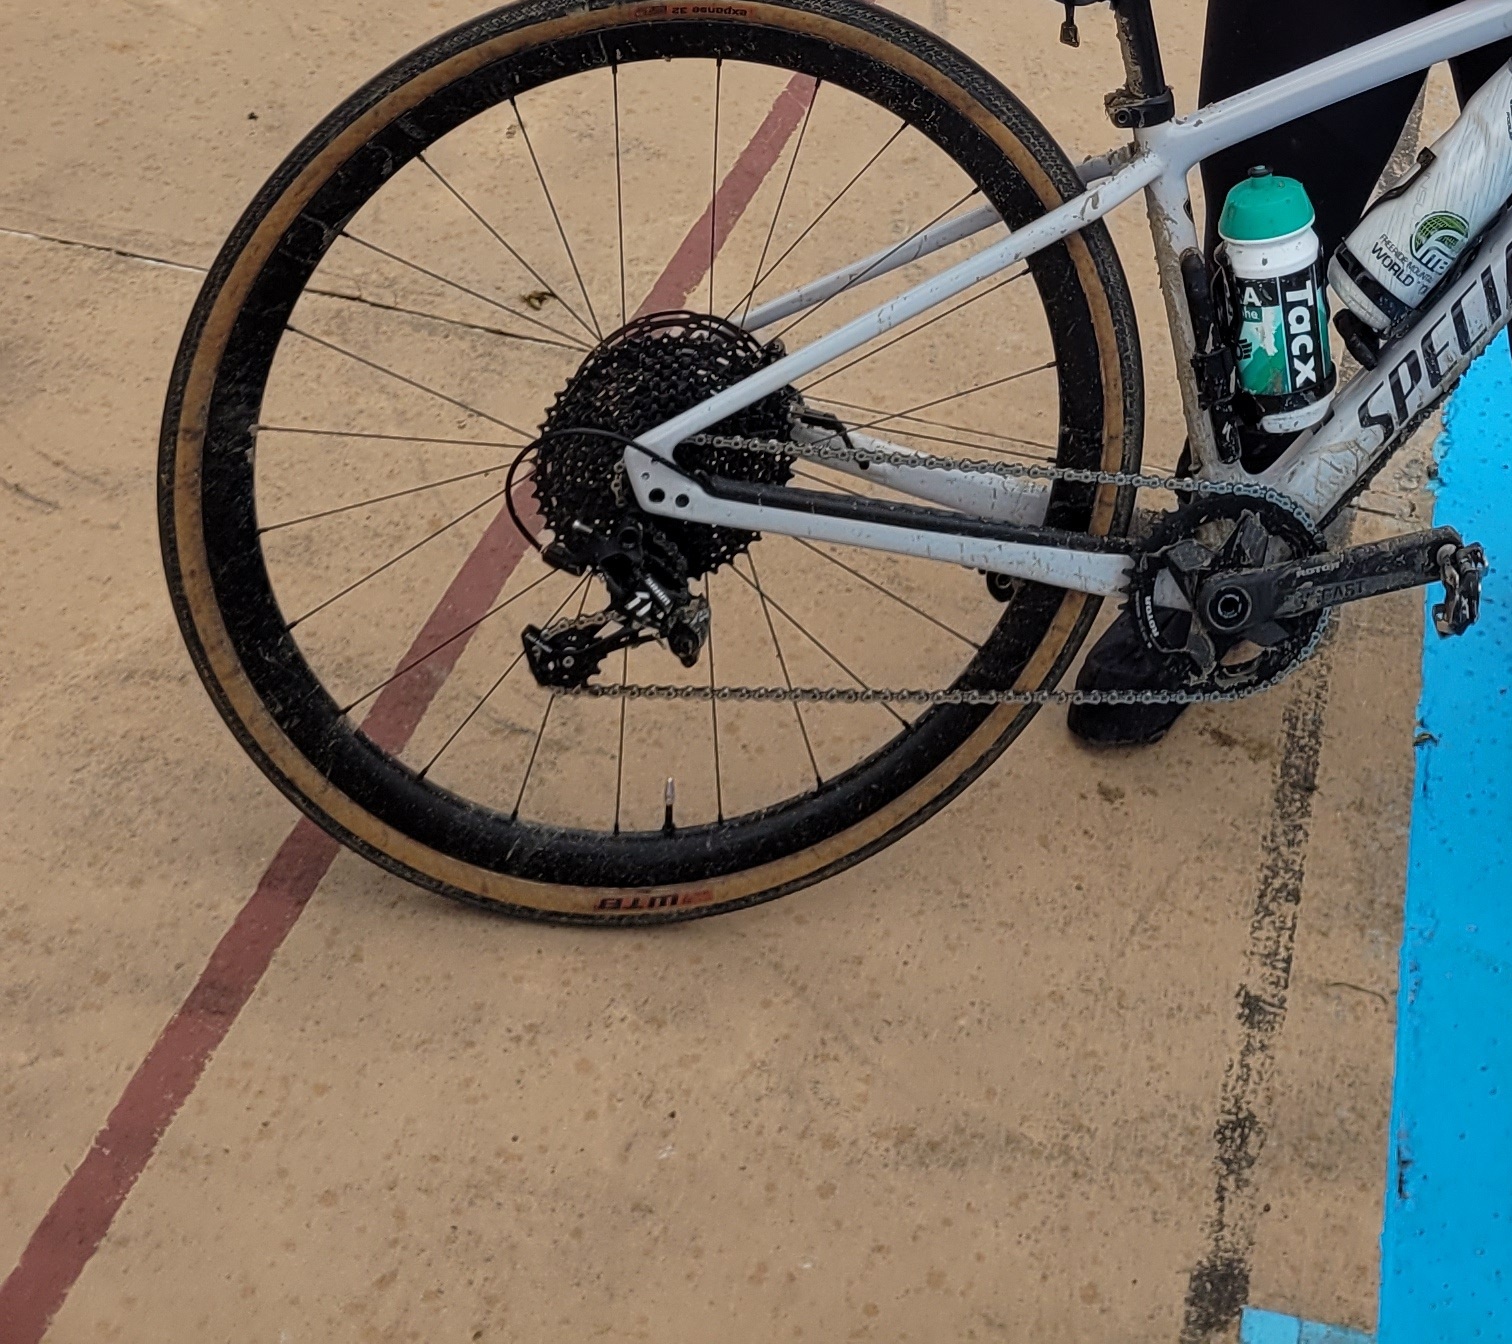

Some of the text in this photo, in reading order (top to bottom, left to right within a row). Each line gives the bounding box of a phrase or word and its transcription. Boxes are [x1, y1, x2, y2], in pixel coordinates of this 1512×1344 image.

[691, 5, 748, 17] expanse
[1371, 241, 1415, 288] WORLD
[1285, 279, 1317, 389] Tacx
